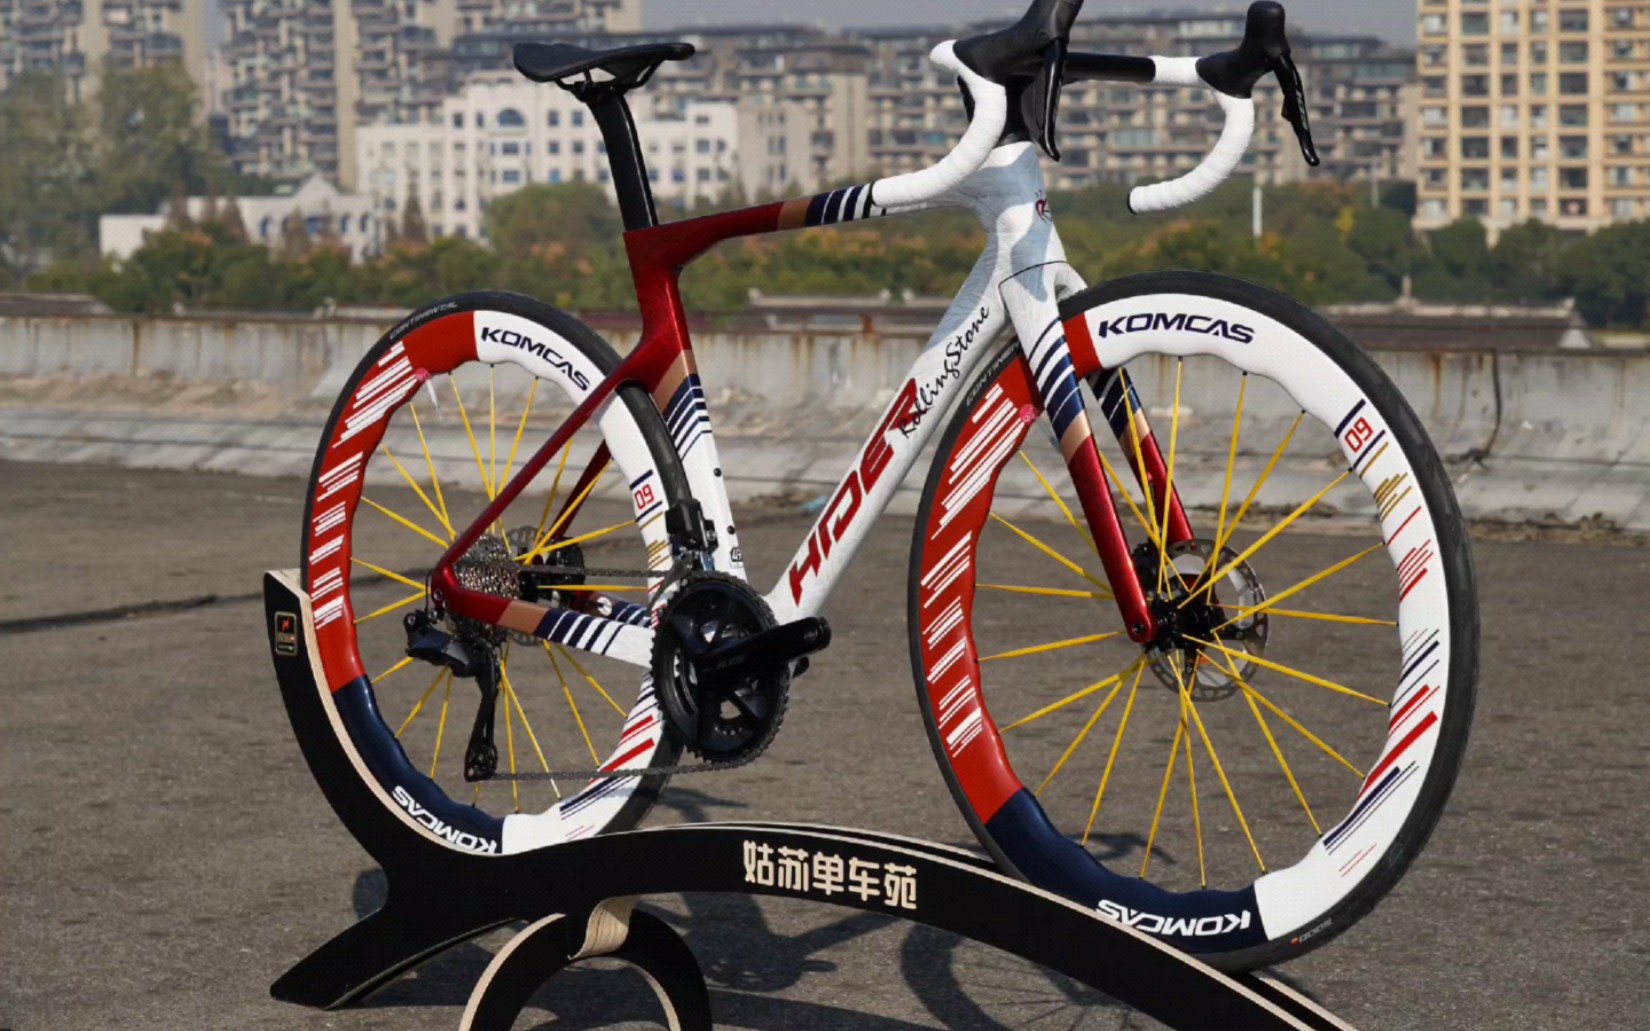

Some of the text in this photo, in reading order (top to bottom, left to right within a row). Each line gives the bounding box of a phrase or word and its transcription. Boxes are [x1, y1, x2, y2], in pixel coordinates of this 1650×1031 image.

[1098, 312, 1255, 344] KOMCAS
[481, 325, 590, 392] KOMCAS
[1344, 416, 1374, 454] 09
[633, 484, 656, 510] 09
[787, 376, 917, 607] HIDER
[392, 785, 498, 854] KOMCAS
[743, 840, 917, 910] 姑苏单车苑
[1095, 899, 1251, 937] KOMCAS
